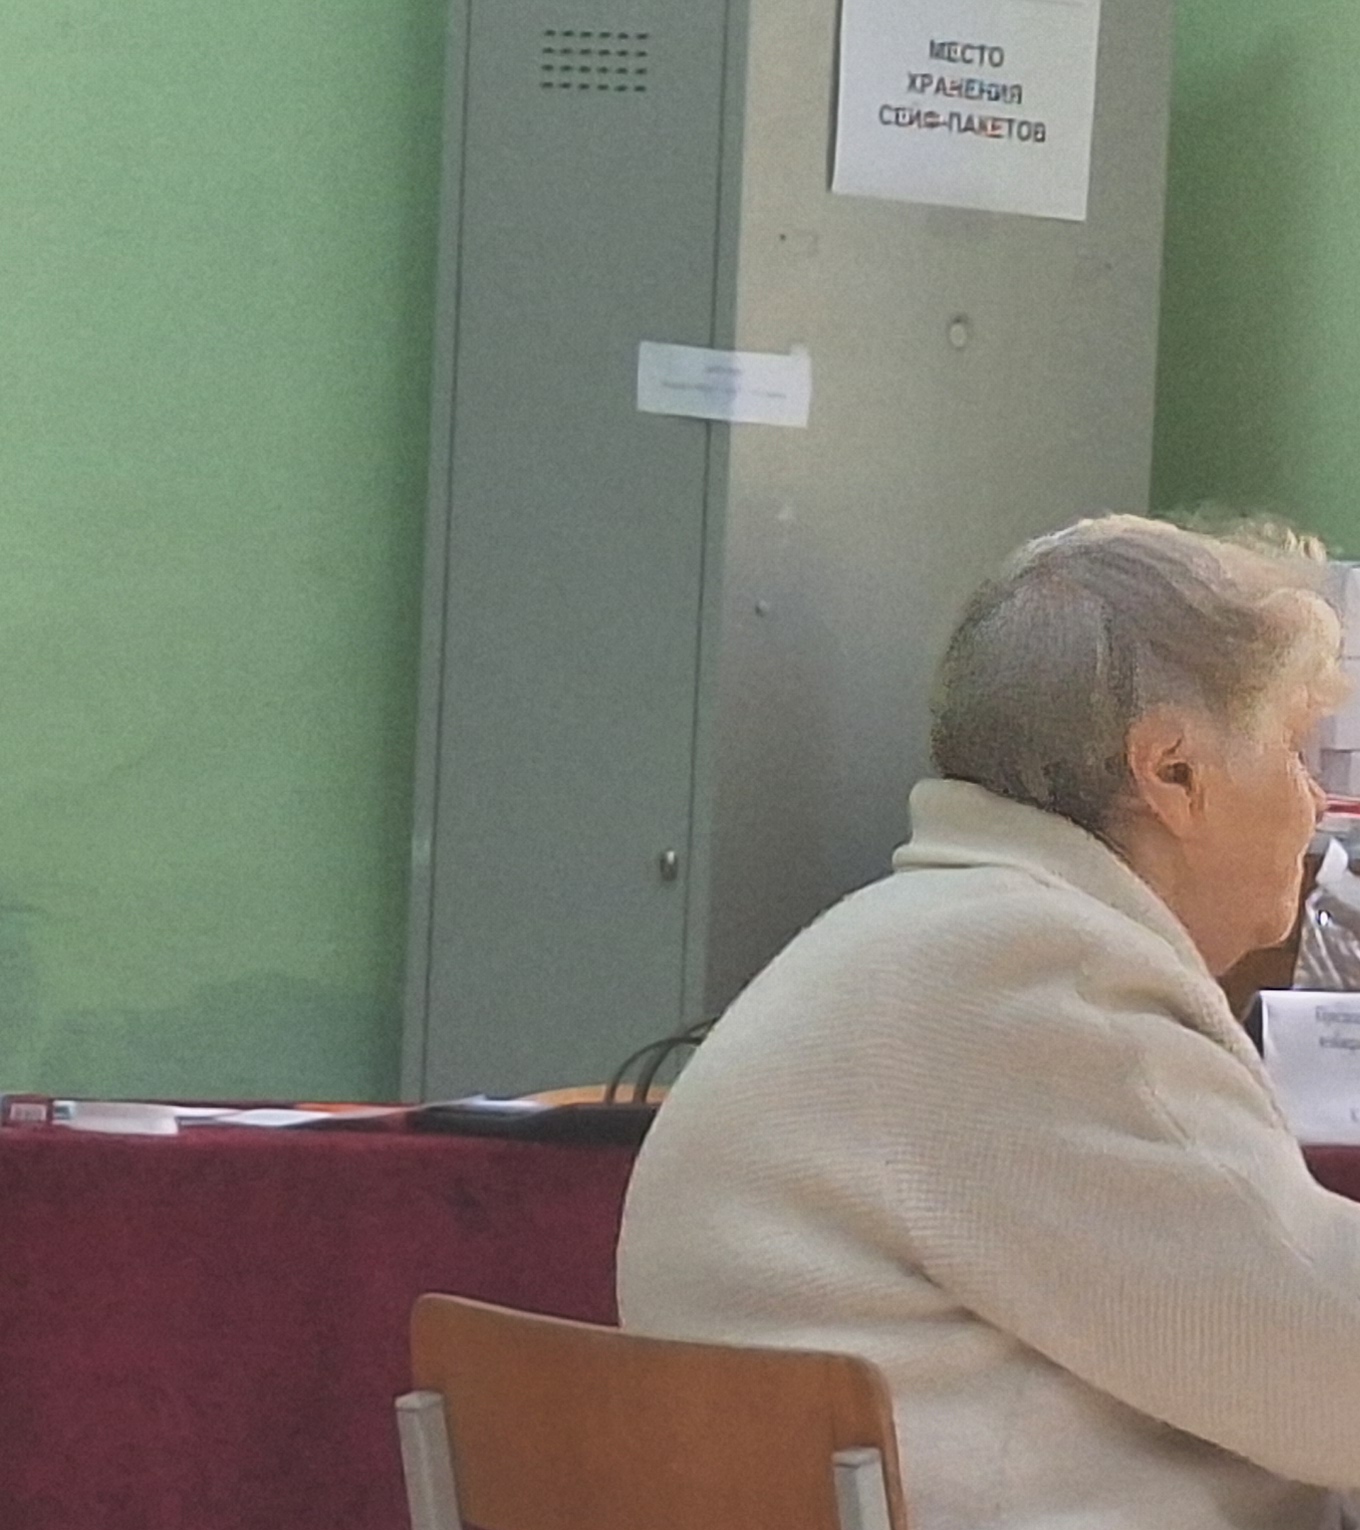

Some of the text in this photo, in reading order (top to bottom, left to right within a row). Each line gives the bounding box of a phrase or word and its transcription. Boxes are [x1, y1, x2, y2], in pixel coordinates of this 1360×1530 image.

[929, 39, 1004, 68] МЕСТО
[906, 72, 1023, 105] ХРАНЕНИЯ
[878, 102, 1046, 143] СЕЙФ-ПАКЕТОВ
